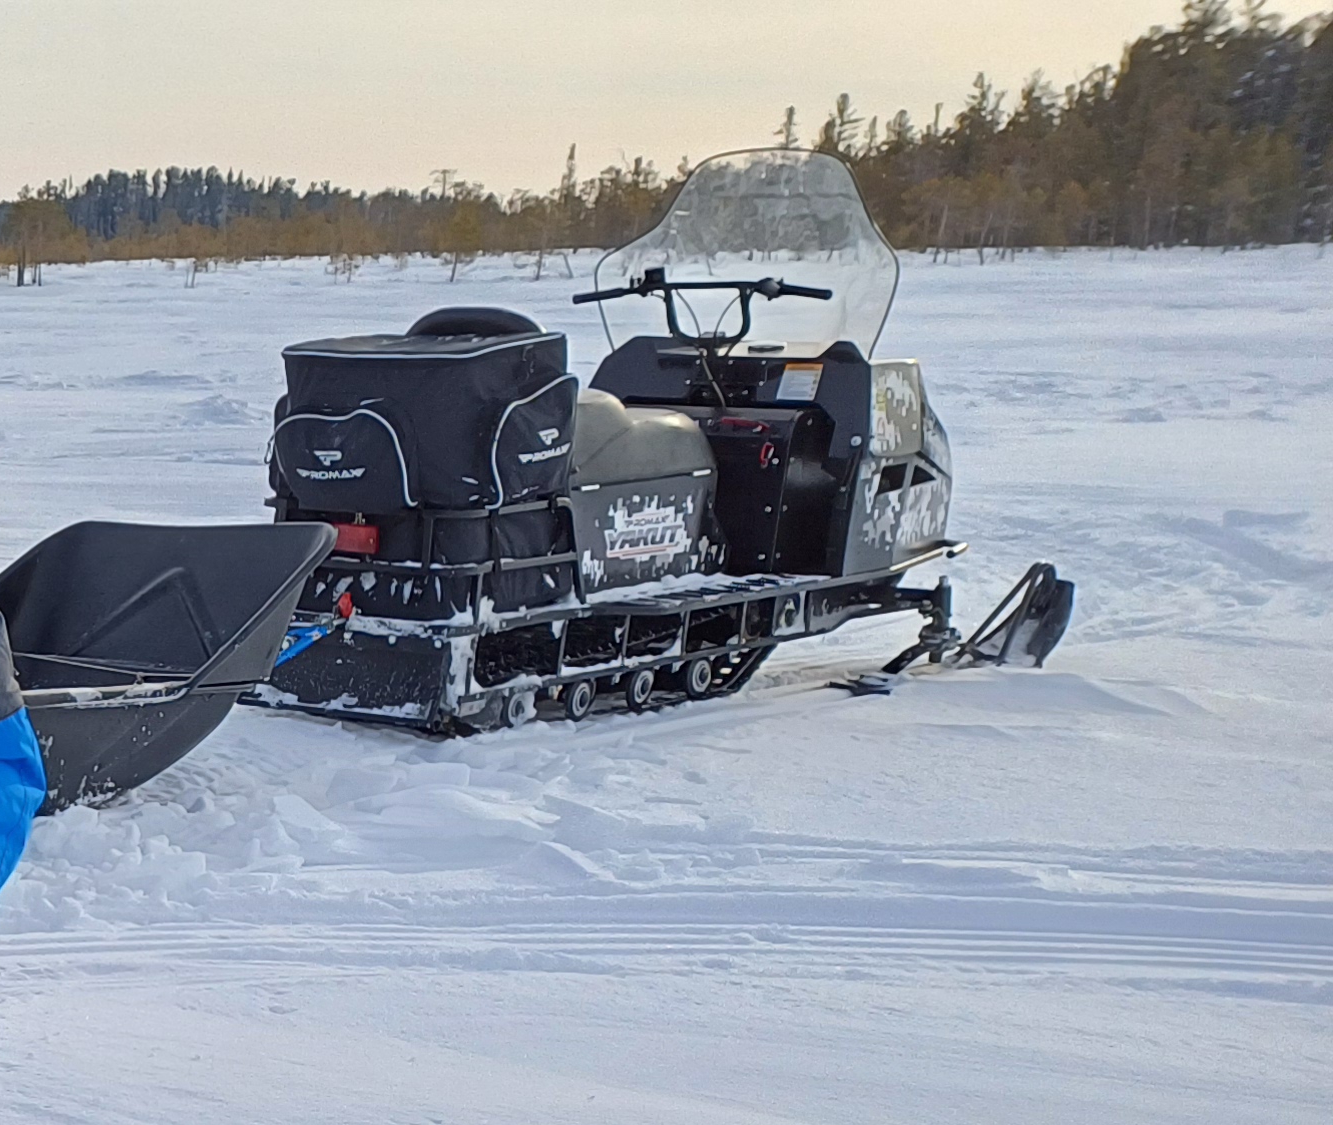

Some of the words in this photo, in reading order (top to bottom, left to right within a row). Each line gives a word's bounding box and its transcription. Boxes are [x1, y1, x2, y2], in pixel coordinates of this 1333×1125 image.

[295, 467, 366, 480] PROMAX
[624, 514, 671, 529] PROMAX
[607, 525, 684, 552] YAKUT
